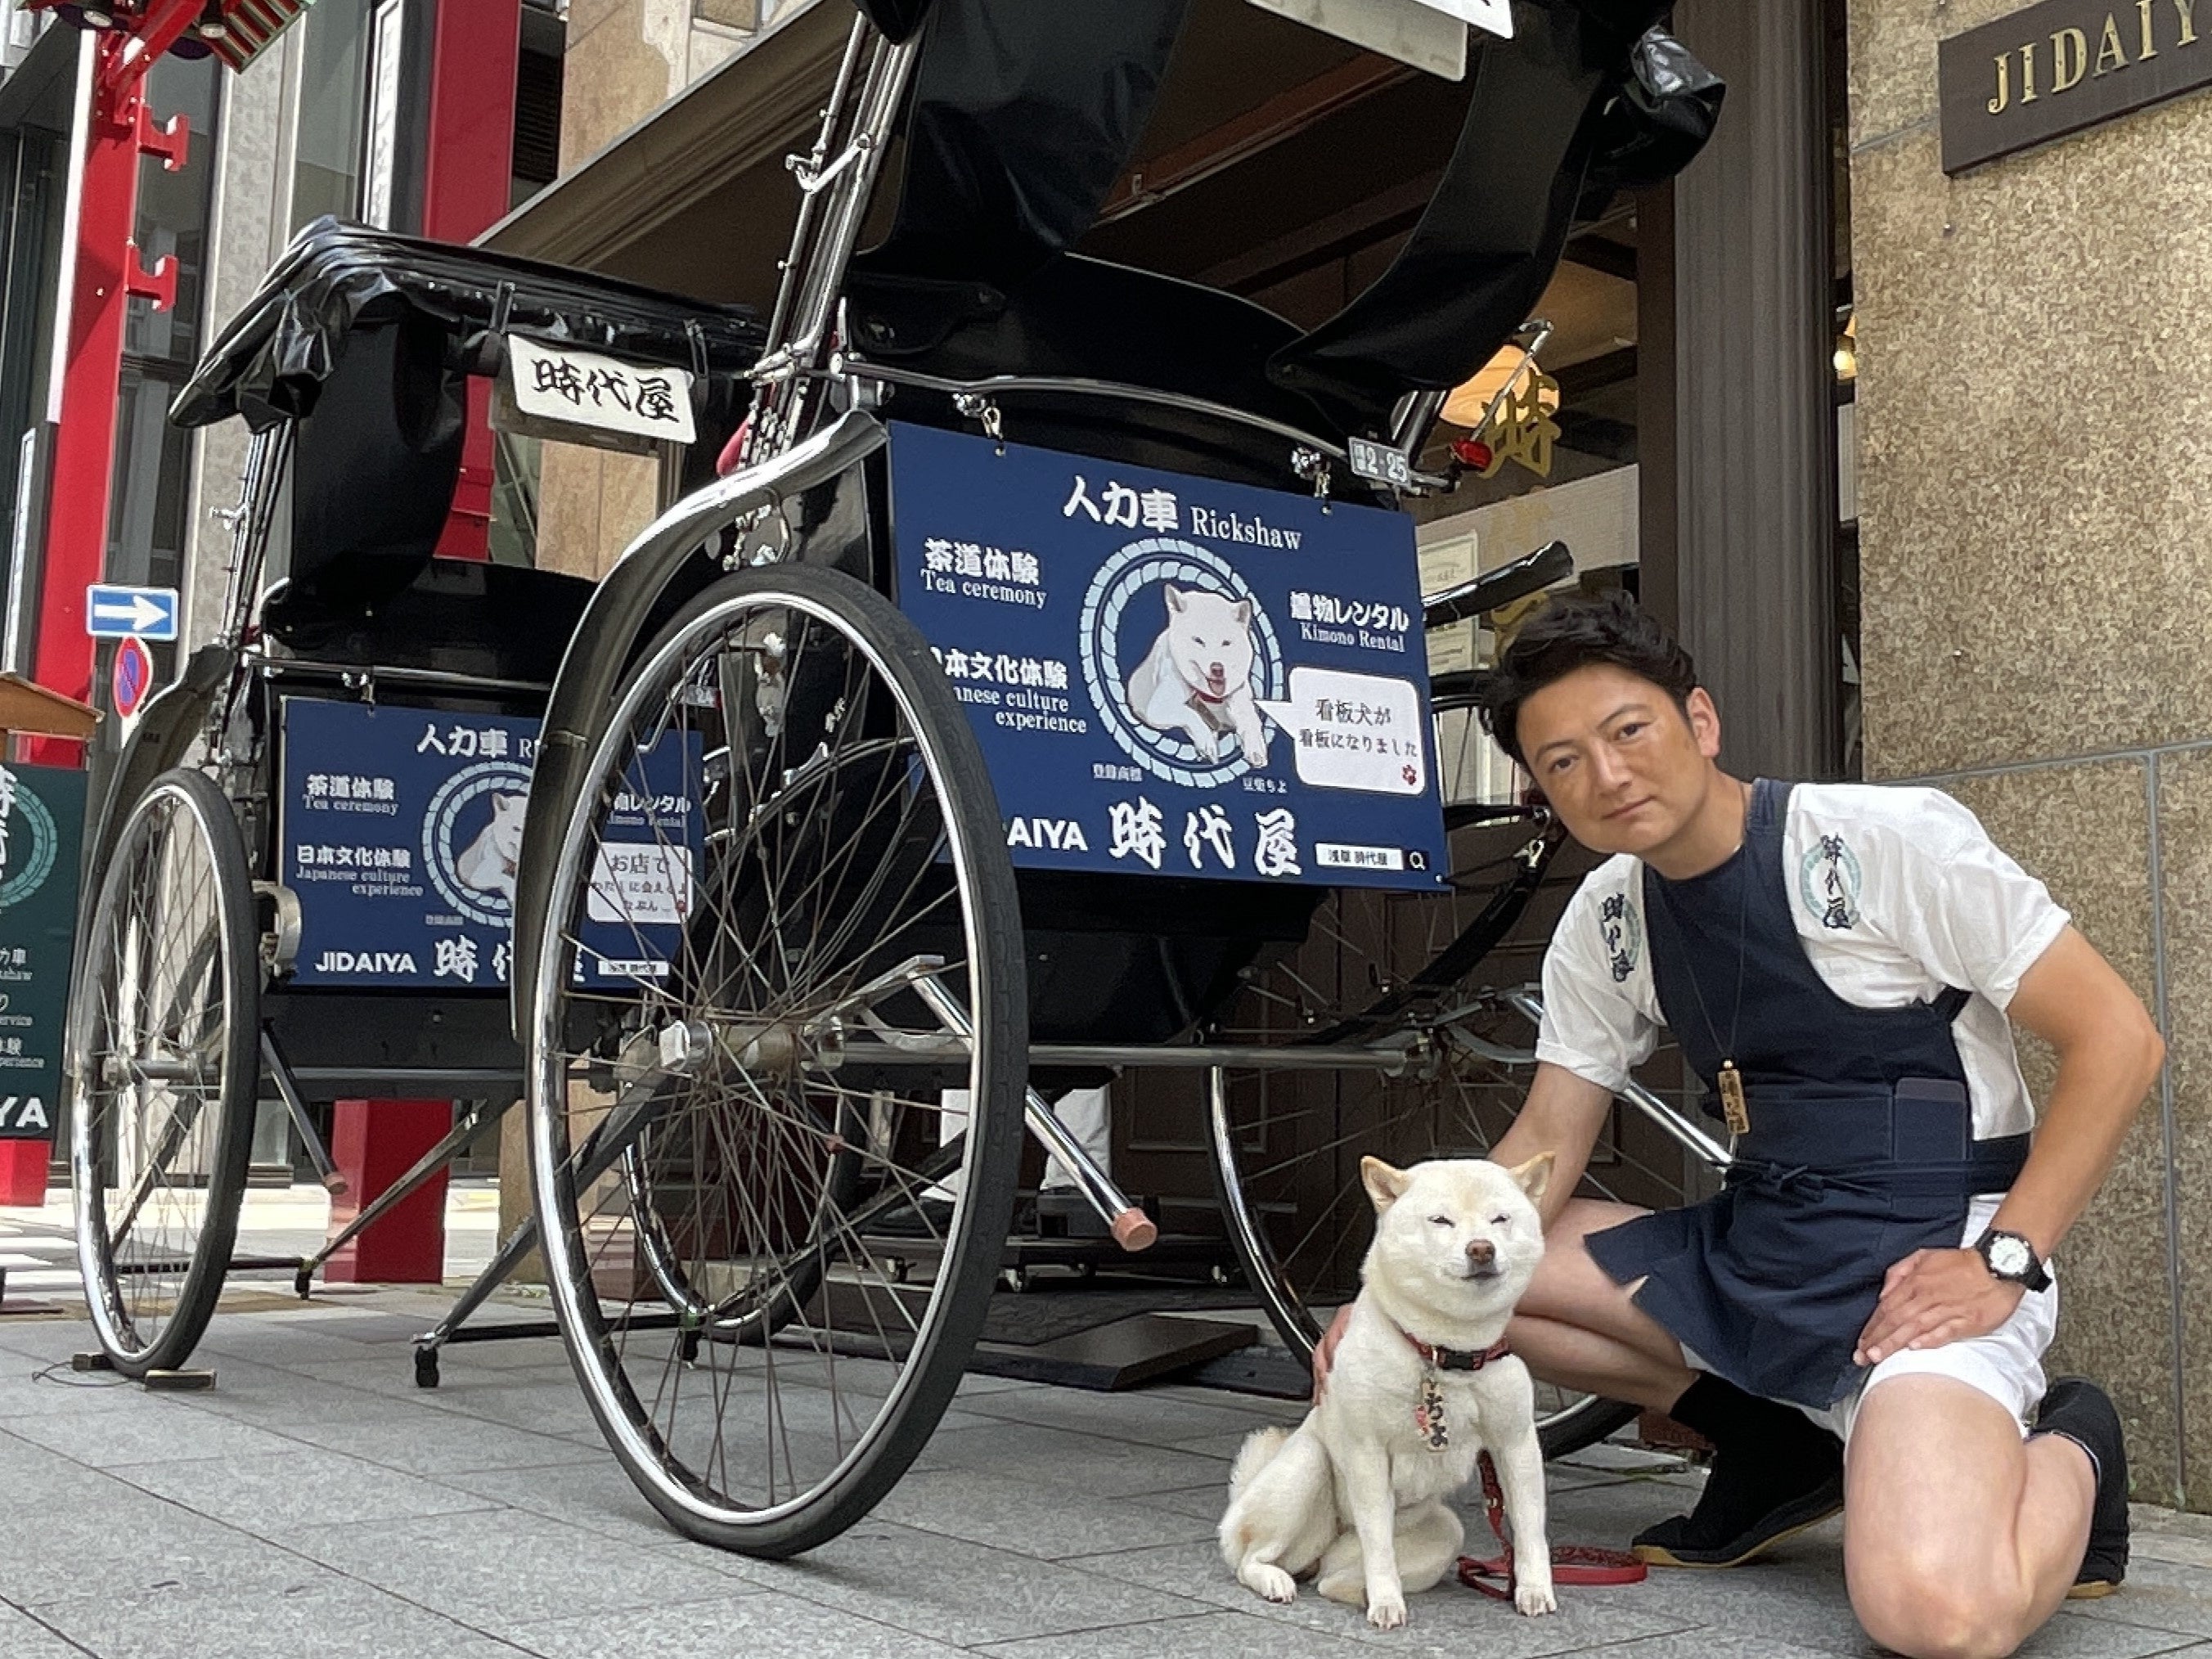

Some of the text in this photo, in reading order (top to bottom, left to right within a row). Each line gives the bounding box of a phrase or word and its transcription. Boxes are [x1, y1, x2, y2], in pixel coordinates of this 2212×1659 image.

[1988, 0, 2200, 115] JIDAIY
[532, 357, 680, 423] 時代屋
[1063, 475, 1302, 550] 人力車 Rickshaw
[924, 537, 1040, 586] 茶道体験
[920, 568, 1047, 609] Tea ceremony
[1300, 622, 1355, 645] Kimono
[1359, 631, 1405, 652] Rental
[1005, 689, 1068, 713] culture
[1315, 699, 1391, 726] 看板犬が
[995, 710, 1086, 733] experience
[416, 724, 508, 758] 人力車
[1299, 729, 1417, 758] 看板になりました
[333, 799, 398, 816] ceremony
[1006, 796, 1302, 876] AIYA 時代屋
[296, 845, 411, 869] 日本文化体験
[295, 866, 357, 883] Japanese
[352, 883, 424, 897] experience
[315, 951, 417, 973] JIDAIYA
[0, 1097, 49, 1128] YA
